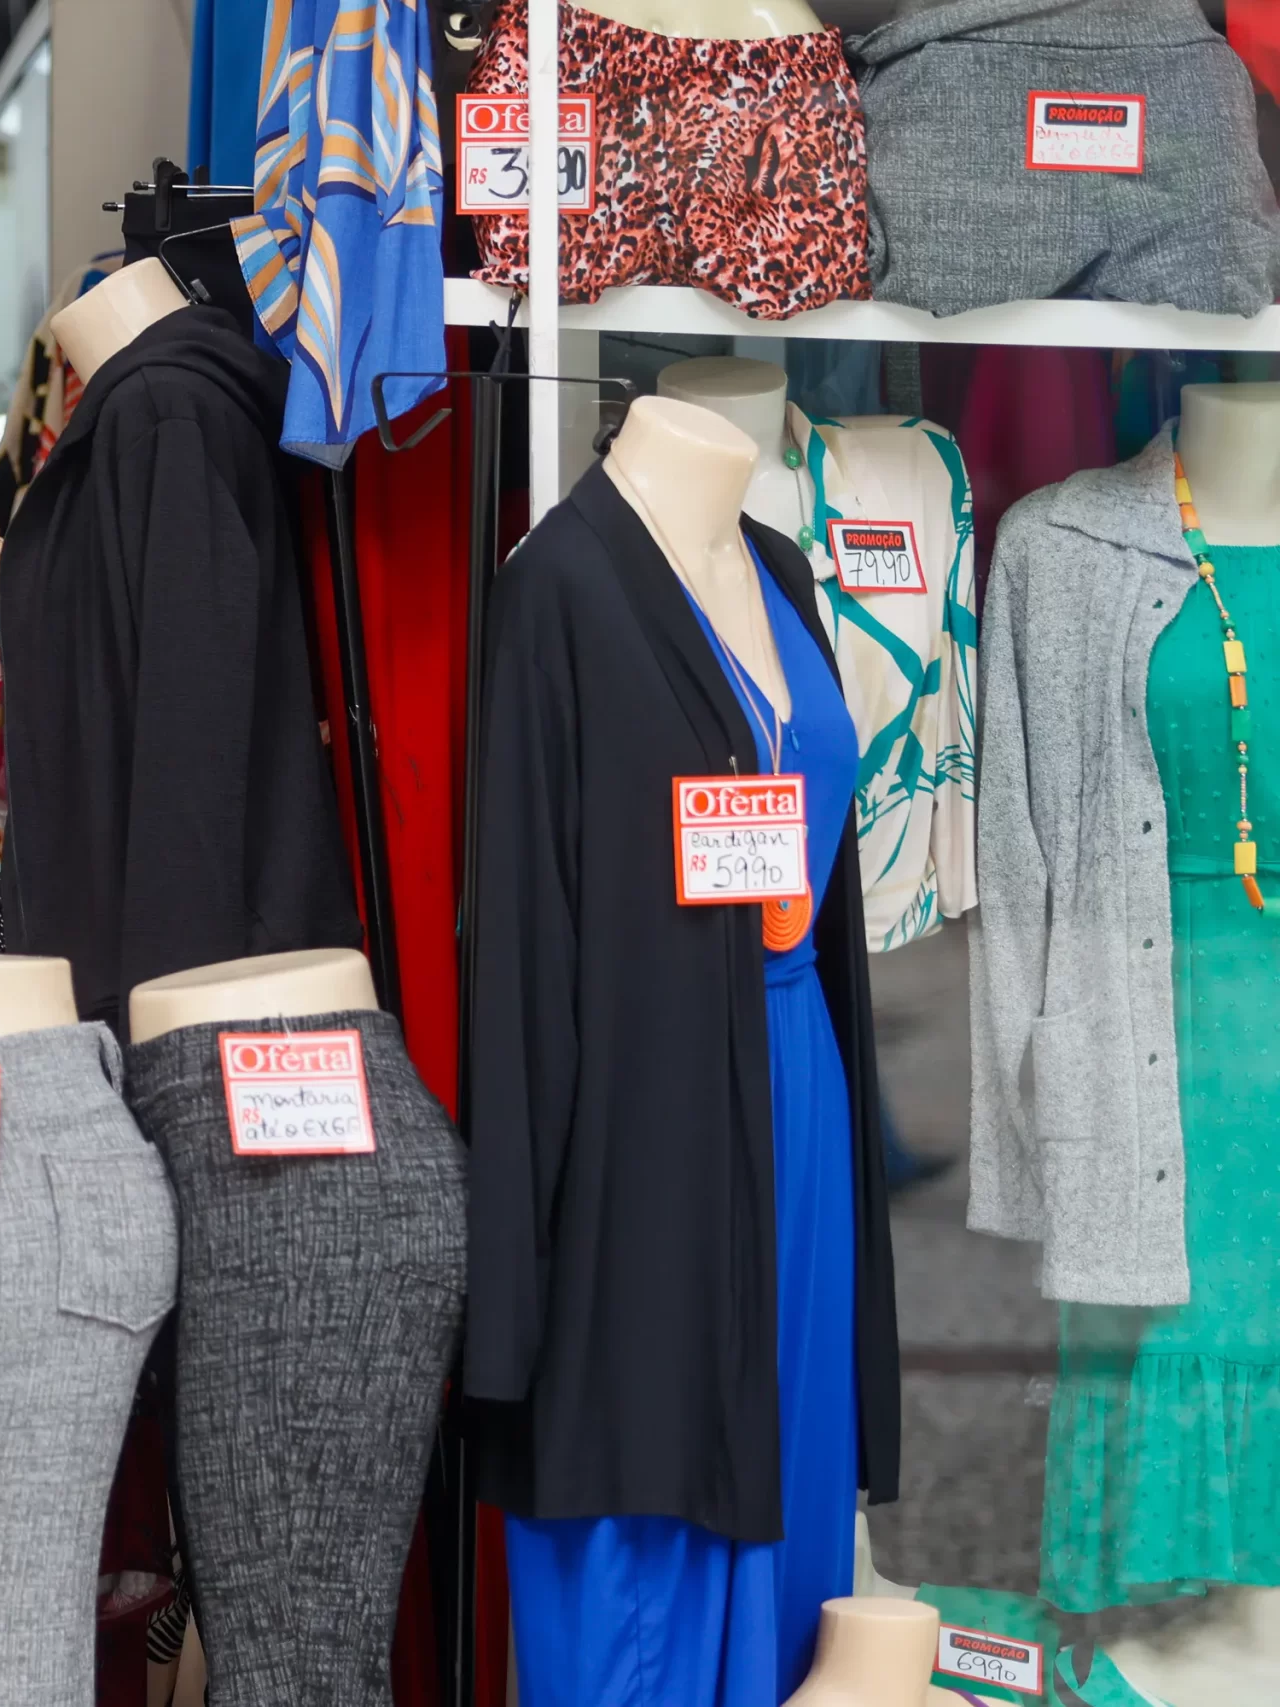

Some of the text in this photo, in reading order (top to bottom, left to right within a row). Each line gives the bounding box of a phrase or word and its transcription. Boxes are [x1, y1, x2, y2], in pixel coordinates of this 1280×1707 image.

[468, 104, 584, 132] Ofea
[1048, 106, 1125, 124] PROMOÇÃO
[845, 532, 903, 548] PROMOÇÃO
[685, 786, 796, 817] Oferta
[232, 1044, 349, 1073] Oferta
[953, 1636, 1026, 1660] PROMOÇÃO
